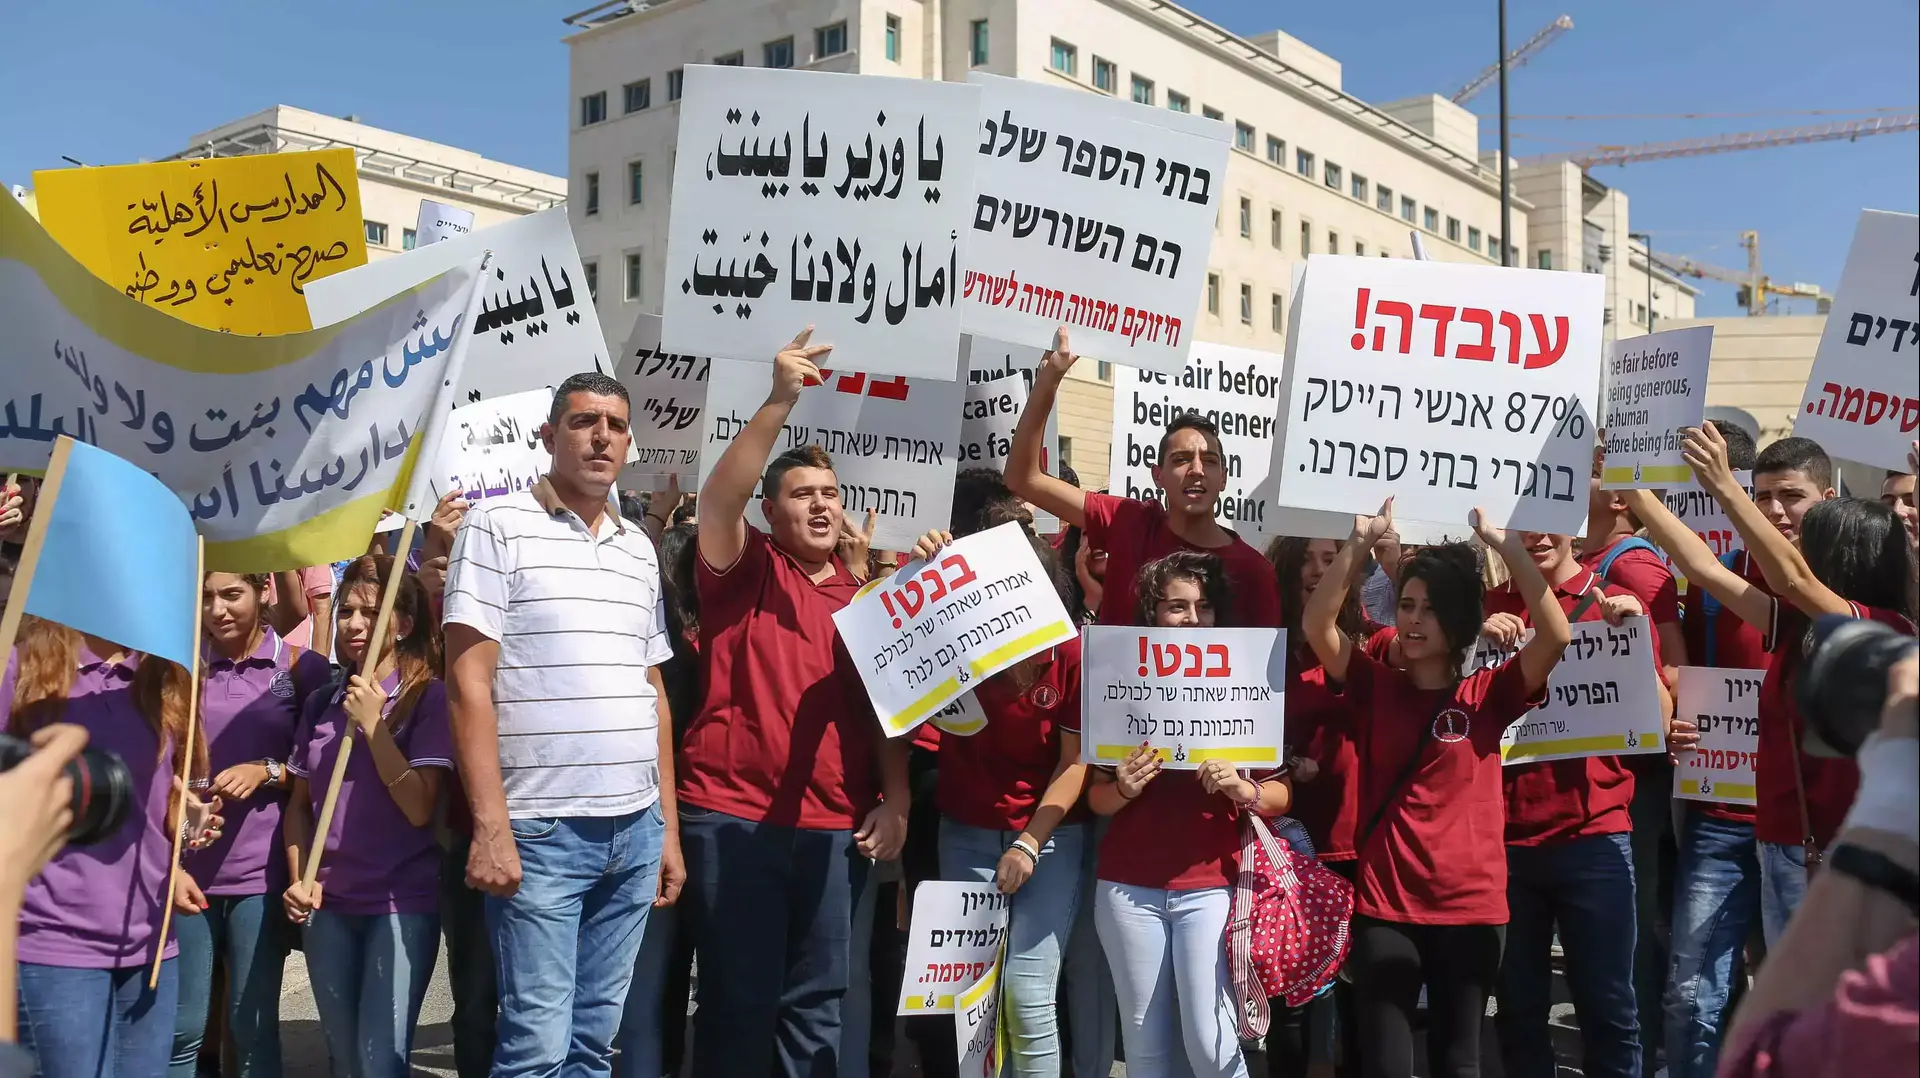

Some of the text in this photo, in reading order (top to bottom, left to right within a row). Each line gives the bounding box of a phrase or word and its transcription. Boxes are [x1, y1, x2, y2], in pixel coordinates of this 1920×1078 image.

[706, 107, 943, 204] يا وزير يا بينت،
[979, 110, 1211, 205] בתי הספר שלנ
[229, 162, 347, 223] المدارس
[973, 194, 1182, 280] הם השורשים
[206, 236, 284, 306] تعليمي
[285, 240, 349, 294] صرح
[541, 253, 580, 326] يا
[791, 232, 876, 324] ولادنا
[885, 229, 957, 325] أمال
[963, 269, 1182, 347] חיזוקם מהווה חזרה לשורש
[1350, 287, 1570, 370] עובדה!
[1846, 312, 1918, 353] ידים
[635, 341, 696, 380] הילד
[1175, 358, 1213, 390] air
[1218, 360, 1282, 399] befor
[1622, 352, 1640, 374] fair
[1641, 347, 1679, 371] before
[294, 360, 373, 434] مهم
[1303, 377, 1585, 440] 87% אנשי הייטק
[1634, 378, 1691, 404] generous,
[114, 381, 175, 454] ولا
[189, 396, 280, 452] بنت
[782, 424, 809, 448] שר
[1615, 407, 1648, 427] human
[680, 449, 698, 464] שר
[883, 436, 944, 466] אמרת
[1127, 433, 1156, 469] be
[1632, 431, 1661, 457] being
[1299, 438, 1575, 502] בוגרי בתי ספרנו.
[841, 484, 917, 518] התכוונ
[880, 554, 977, 630] בנט!
[873, 570, 1033, 675] אמרת שאתה שר לכולם,
[902, 604, 1032, 689] התכוונת גם לנו?
[1138, 636, 1232, 678] בנט!
[1103, 680, 1270, 702] אמרת שאתה שר לכולם,
[1555, 681, 1619, 707] הפרטי
[1126, 713, 1254, 737] התכוונת גם לנו?
[1512, 721, 1548, 741] החינוך
[1697, 713, 1760, 736] מידים
[918, 962, 984, 983] סיסמה.
